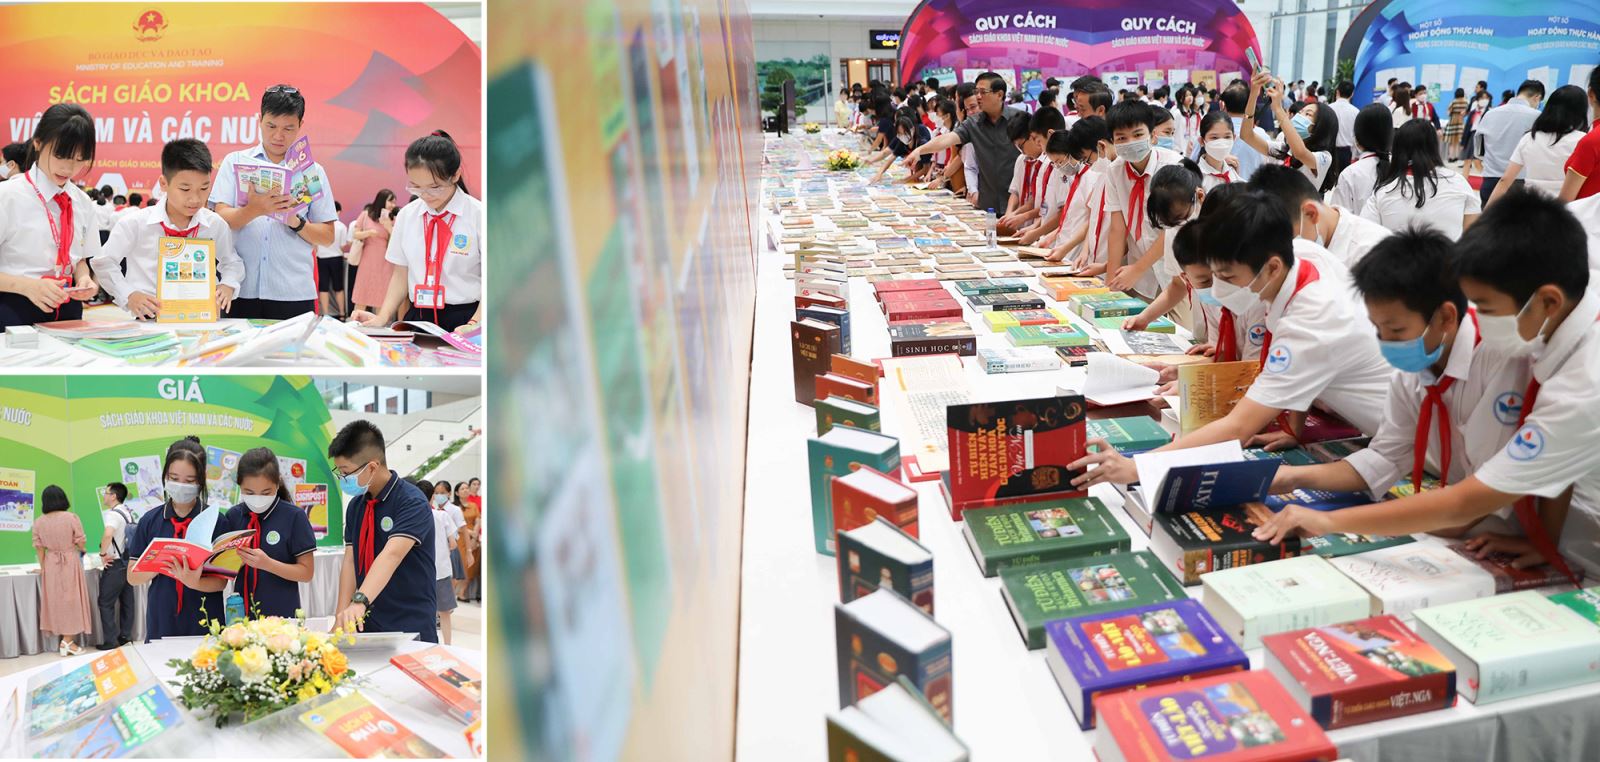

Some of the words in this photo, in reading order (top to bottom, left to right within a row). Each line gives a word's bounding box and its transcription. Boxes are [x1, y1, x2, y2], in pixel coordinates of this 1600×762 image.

[975, 15, 1010, 32] QUY
[1013, 11, 1057, 29] CÁCH
[1121, 17, 1154, 31] QUY
[1155, 15, 1197, 34] CÁCH
[1419, 21, 1433, 30] MỘT
[1433, 18, 1443, 27] SỐ
[1547, 15, 1561, 24] MỘT
[1560, 16, 1570, 25] SỐ
[1408, 30, 1429, 41] HOẠT
[1429, 27, 1452, 37] ĐỘNG
[1452, 26, 1472, 36] THỰC
[1472, 26, 1494, 37] HÀNH
[1527, 27, 1547, 37] HOẠT
[1547, 25, 1568, 36] ĐỘNG
[1568, 28, 1587, 38] THỰC
[75, 62, 109, 72] MINISTRY
[110, 62, 122, 71] OF
[123, 60, 166, 70] EDUCATION
[167, 60, 186, 69] AND
[187, 59, 225, 68] TRAINING
[48, 80, 108, 105] SÁCH
[113, 79, 173, 104] GIÁO
[179, 81, 251, 103] KHOA
[124, 113, 153, 143] VÀ
[161, 110, 212, 144] CÁC
[905, 345, 928, 354] SINH
[930, 343, 950, 354] HỌC
[157, 375, 205, 404] GIÁ
[4, 405, 32, 427] NƯỚC
[100, 411, 124, 430] SÁCH
[125, 410, 146, 427] GIÁO
[146, 411, 169, 426] KHOA
[169, 409, 187, 426] VIỆT
[188, 411, 207, 426] NAM
[207, 411, 219, 427] VÀ
[218, 411, 234, 429] CÁC
[234, 414, 254, 432] NƯỚC
